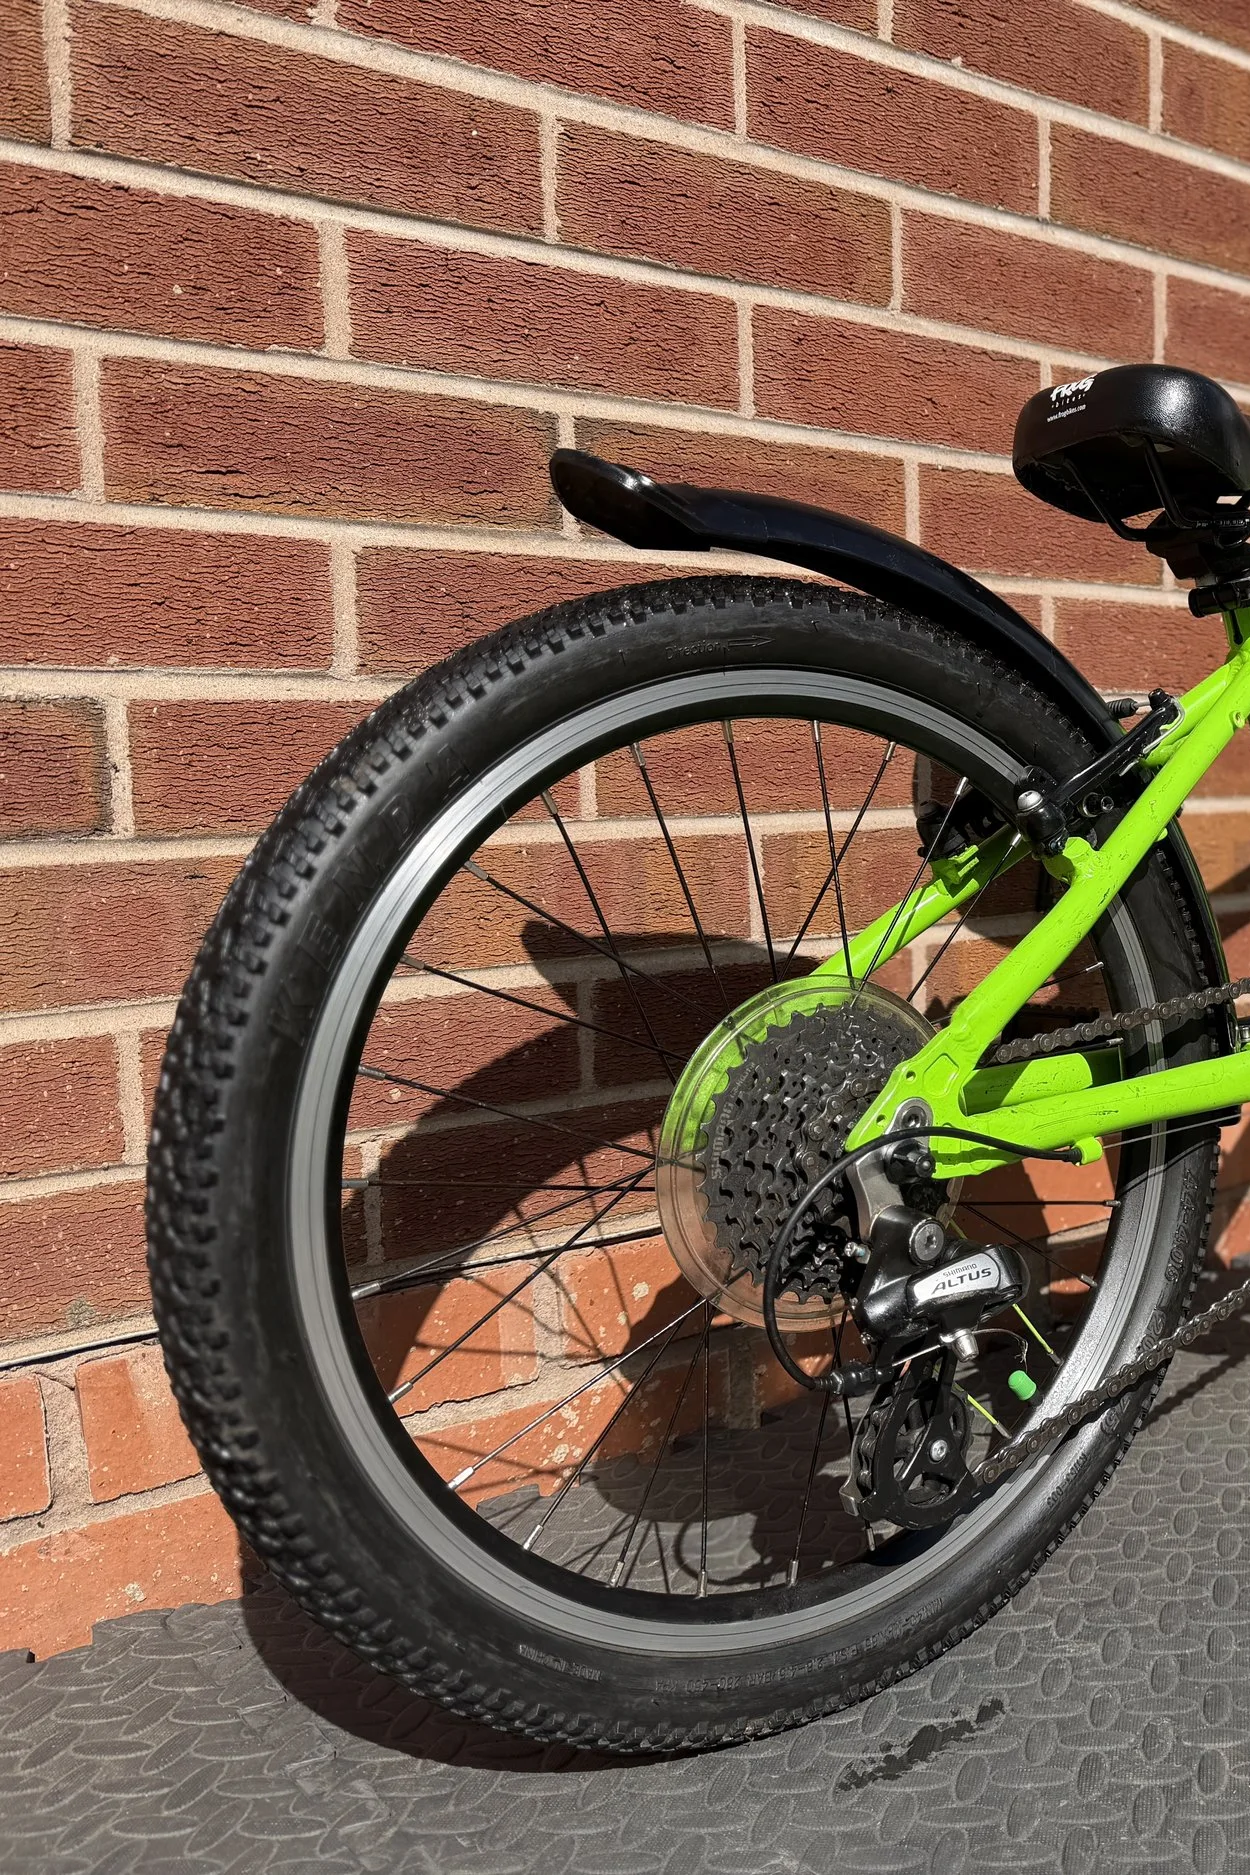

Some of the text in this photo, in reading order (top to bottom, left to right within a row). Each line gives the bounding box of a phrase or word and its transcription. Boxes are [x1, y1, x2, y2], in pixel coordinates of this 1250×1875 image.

[1050, 373, 1096, 402] FROG
[711, 1100, 735, 1181] SHIMANO
[1164, 1168, 1199, 1283] 44-406
[931, 1267, 992, 1296] ALTUS
[943, 1263, 978, 1278] SHIMANO
